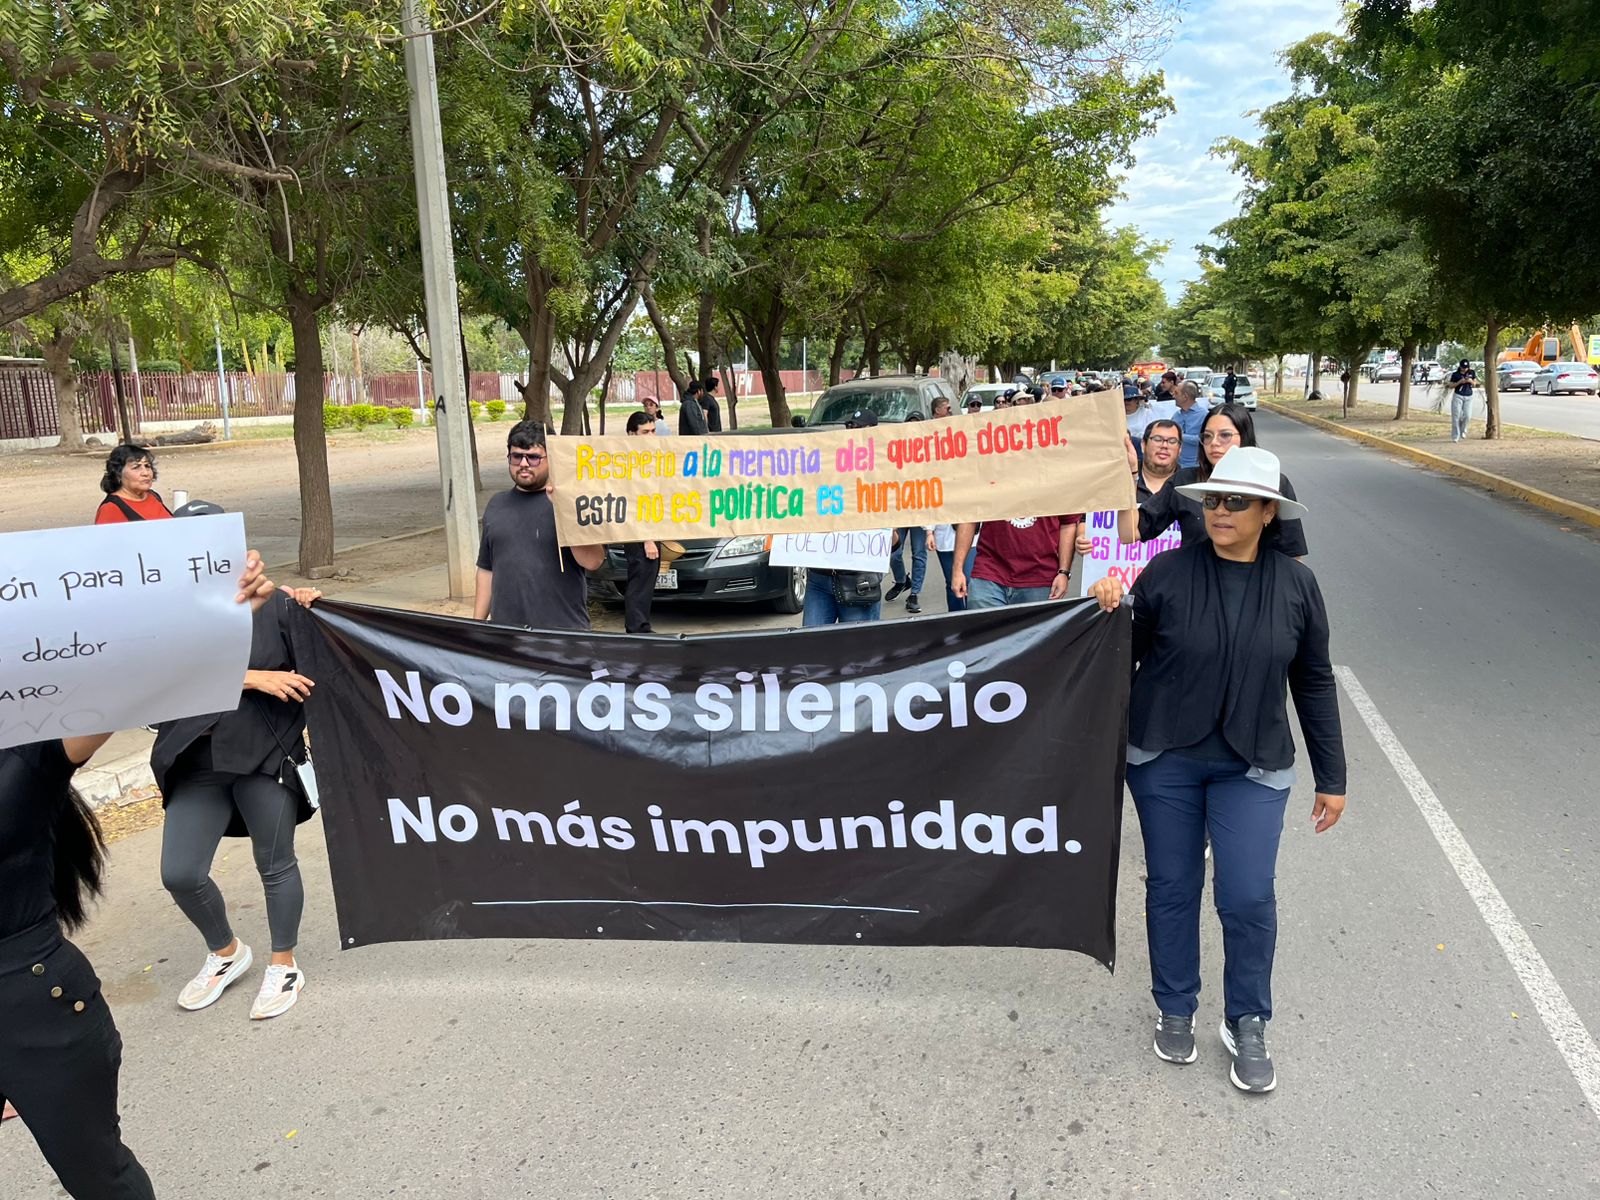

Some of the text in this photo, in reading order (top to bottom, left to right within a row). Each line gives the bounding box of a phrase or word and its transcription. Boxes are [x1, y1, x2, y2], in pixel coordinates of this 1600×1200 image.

[576, 444, 676, 481] Respeto
[728, 445, 822, 478] memoria
[835, 437, 875, 472] del
[887, 425, 968, 470] querido
[977, 415, 1068, 455] doctor,
[575, 493, 627, 526] esto
[636, 493, 665, 524] no
[671, 490, 703, 523] es
[816, 485, 844, 515] es
[857, 477, 944, 513] humano
[1093, 511, 1115, 529] NO
[786, 533, 817, 553] FUE
[1091, 536, 1110, 561] es
[59, 570, 124, 601] para
[137, 552, 162, 585] la
[22, 631, 108, 663] doctor
[374, 660, 1028, 733] No más silencio
[387, 796, 1083, 868] No más impunidad.
